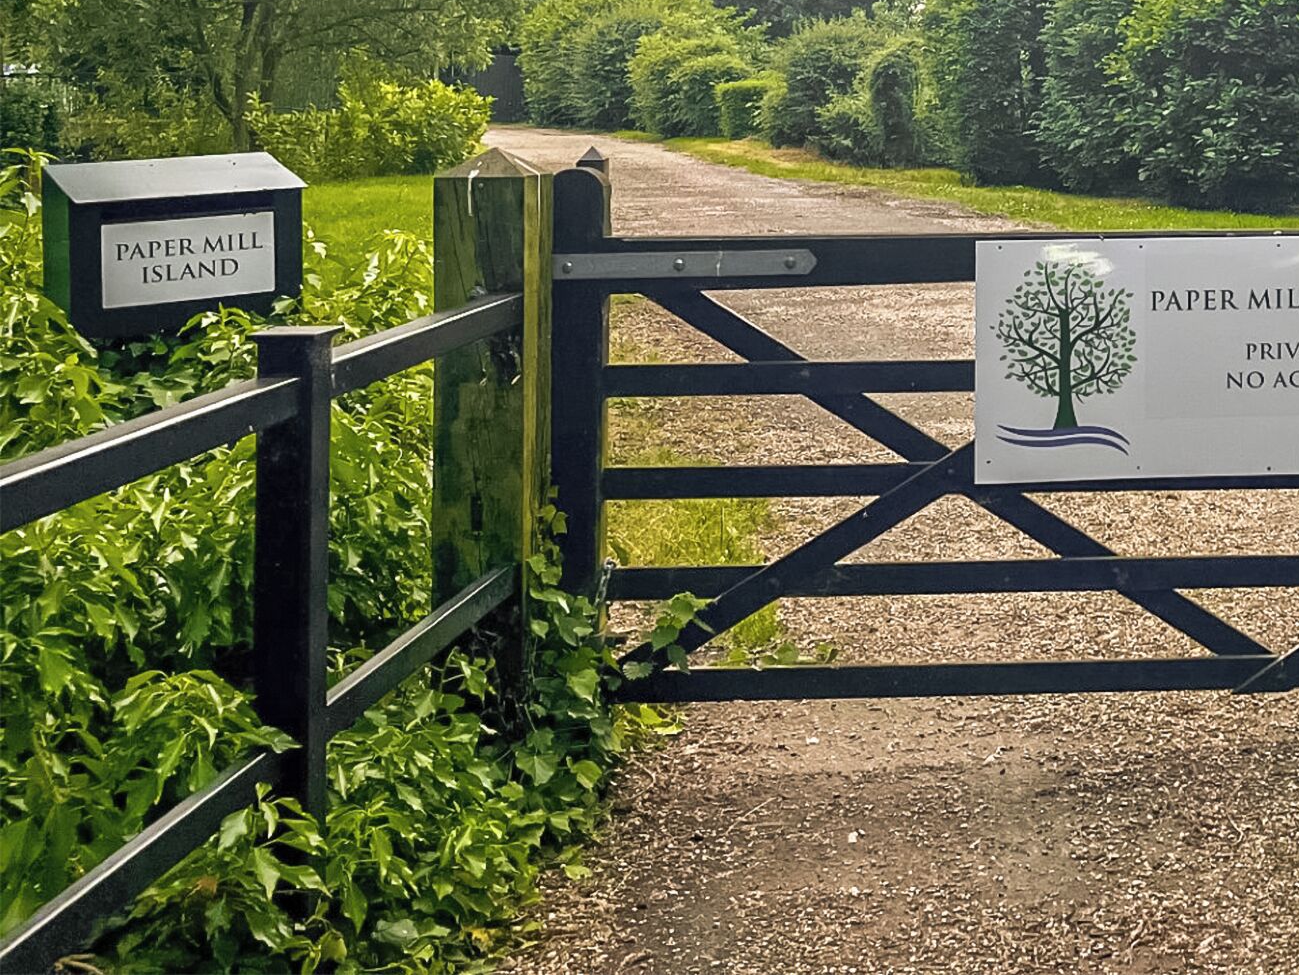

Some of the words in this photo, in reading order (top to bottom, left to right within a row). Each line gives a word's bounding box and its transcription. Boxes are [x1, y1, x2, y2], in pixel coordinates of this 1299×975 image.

[115, 238, 195, 261] PAPER
[203, 231, 263, 253] MILL
[142, 258, 239, 283] ISLAND
[1150, 289, 1239, 312] PAPER
[1225, 371, 1265, 389] NO
